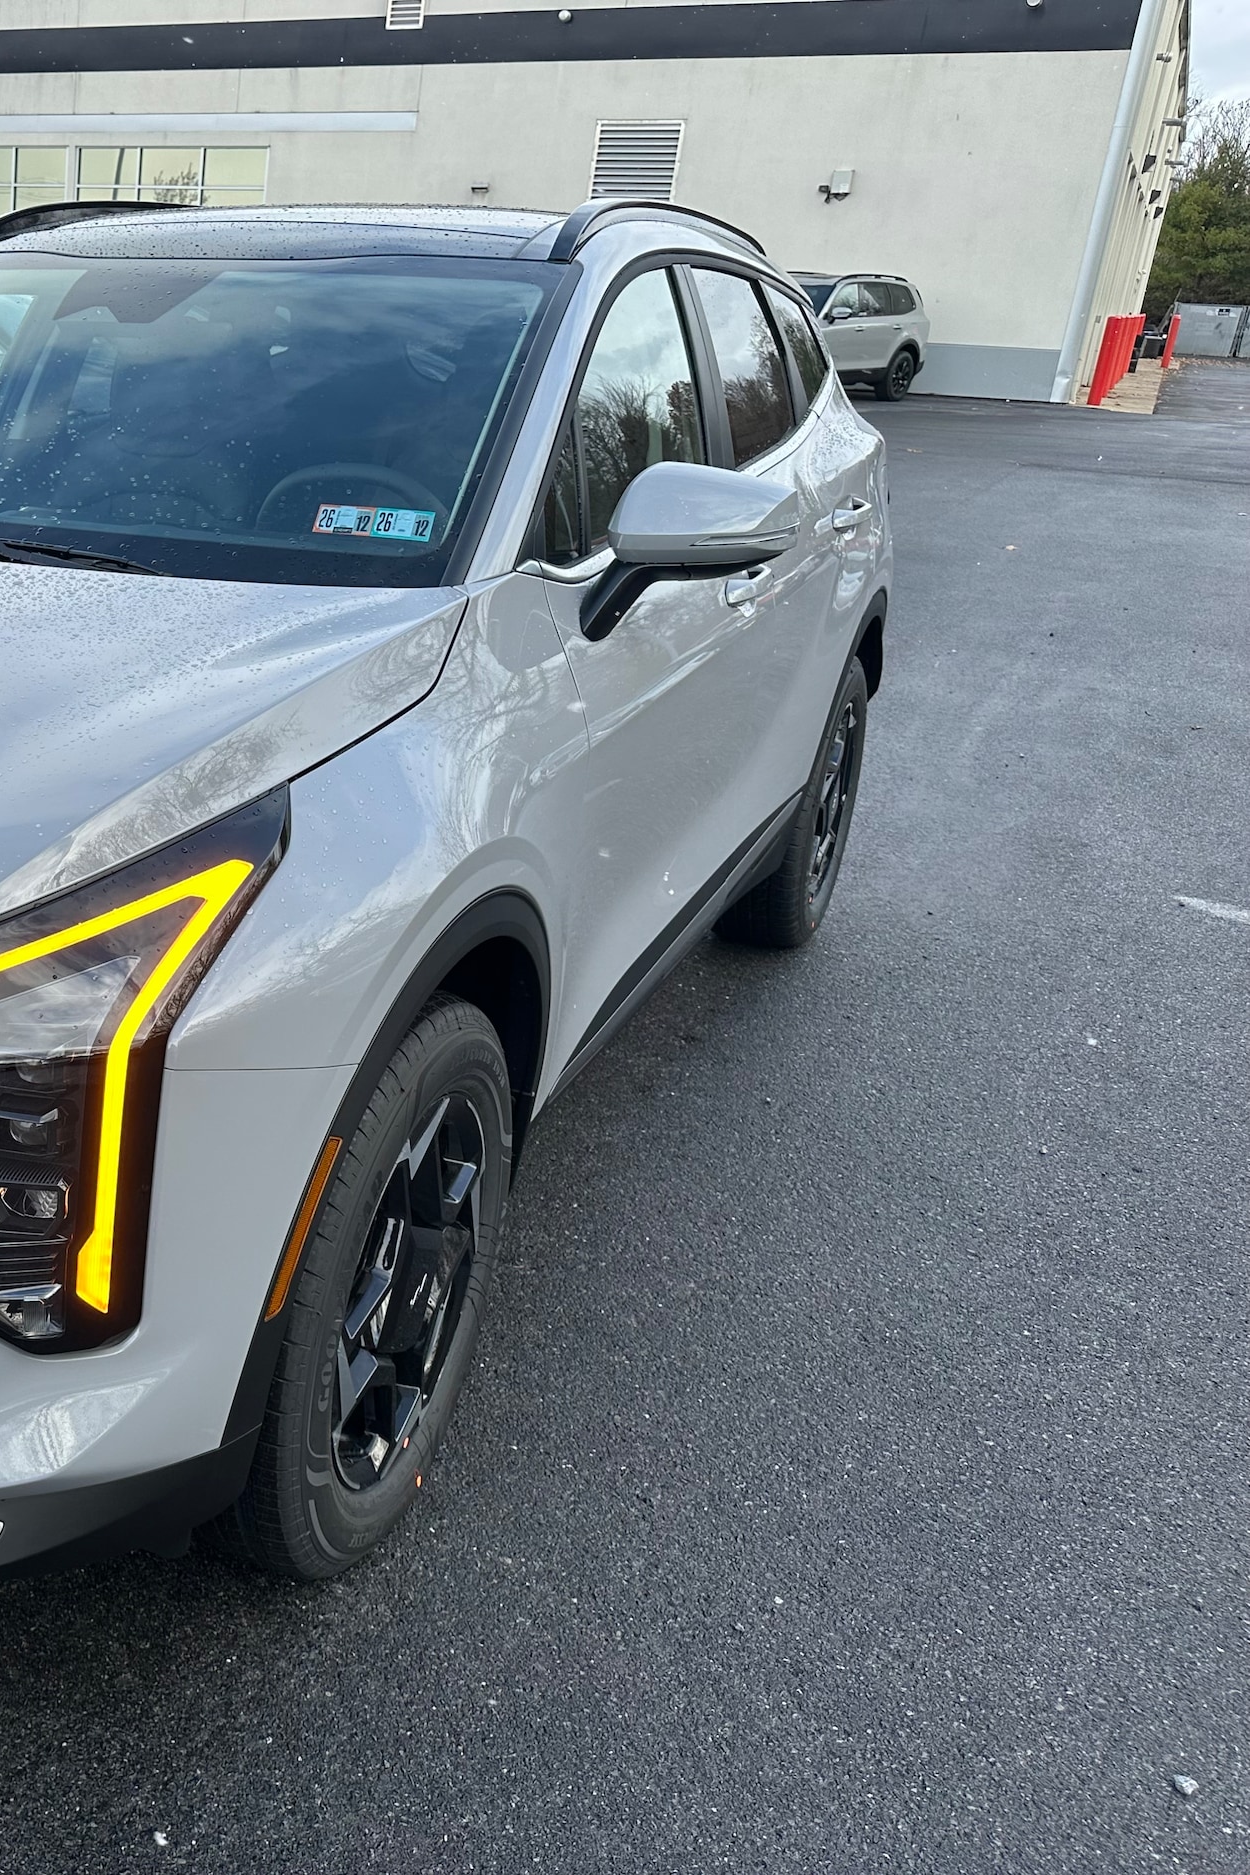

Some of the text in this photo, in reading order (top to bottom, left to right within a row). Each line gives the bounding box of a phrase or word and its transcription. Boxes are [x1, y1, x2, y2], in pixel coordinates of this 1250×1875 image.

[318, 508, 336, 528] 26
[356, 515, 371, 532] 12
[376, 512, 394, 532] 26
[415, 519, 430, 537] 12
